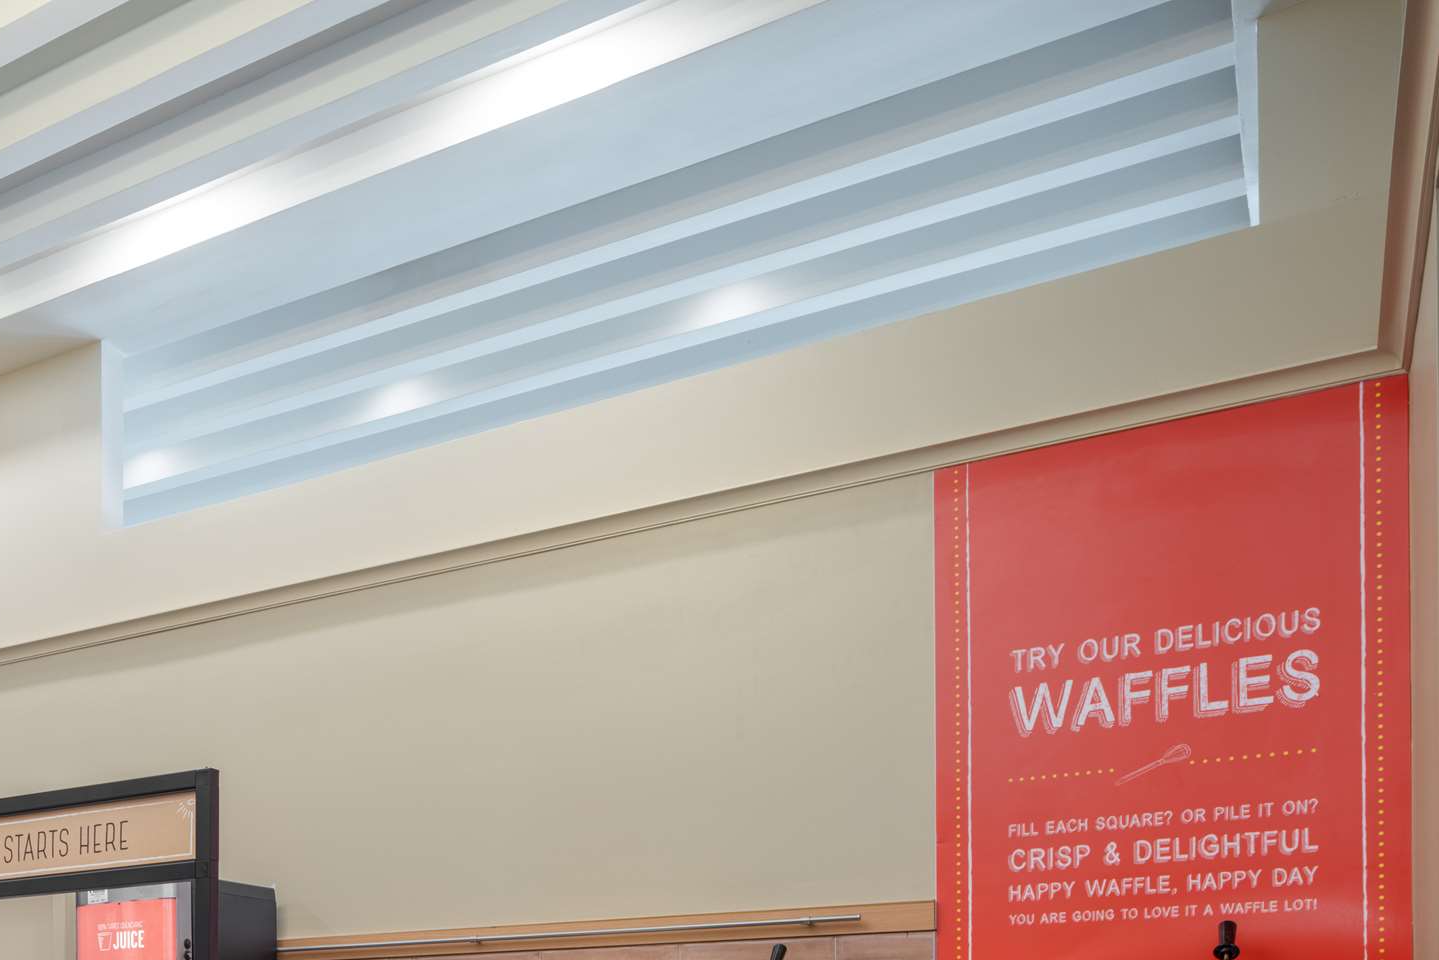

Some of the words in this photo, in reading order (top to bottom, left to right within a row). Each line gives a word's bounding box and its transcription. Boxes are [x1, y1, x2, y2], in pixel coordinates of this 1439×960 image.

[1010, 643, 1064, 673] TRY
[1077, 633, 1141, 665] OUR
[1154, 607, 1321, 655] DELICIOUS
[1010, 649, 1321, 737] WAFFLES
[1008, 822, 1039, 838] FILL
[1046, 818, 1089, 835] EACH
[1095, 811, 1174, 831] SQUARE?
[1181, 808, 1206, 824] OR
[1213, 804, 1251, 822] PILE
[1258, 802, 1275, 818] IT
[1282, 798, 1319, 816] ON?
[3, 827, 69, 864] STARTS
[79, 820, 129, 855] HERE
[1008, 844, 1091, 873] CRISP
[1104, 841, 1121, 866] &
[1133, 827, 1320, 865] DELIGHTFUL
[1008, 881, 1076, 903] HAPPY
[1085, 874, 1178, 898] WAFFLE,
[1186, 869, 1262, 893] HAPPY
[1271, 865, 1319, 888] DAY
[1009, 912, 1035, 926] YOU
[1040, 911, 1067, 925] ARE
[1072, 908, 1115, 922] GOING
[1120, 908, 1138, 920] TO
[1144, 905, 1180, 919] LOVE
[1184, 904, 1198, 917] IT
[1203, 903, 1214, 917] A
[1220, 900, 1279, 915] WAFFLE
[1284, 898, 1318, 912] LOT!
[112, 930, 145, 950] JUICE
